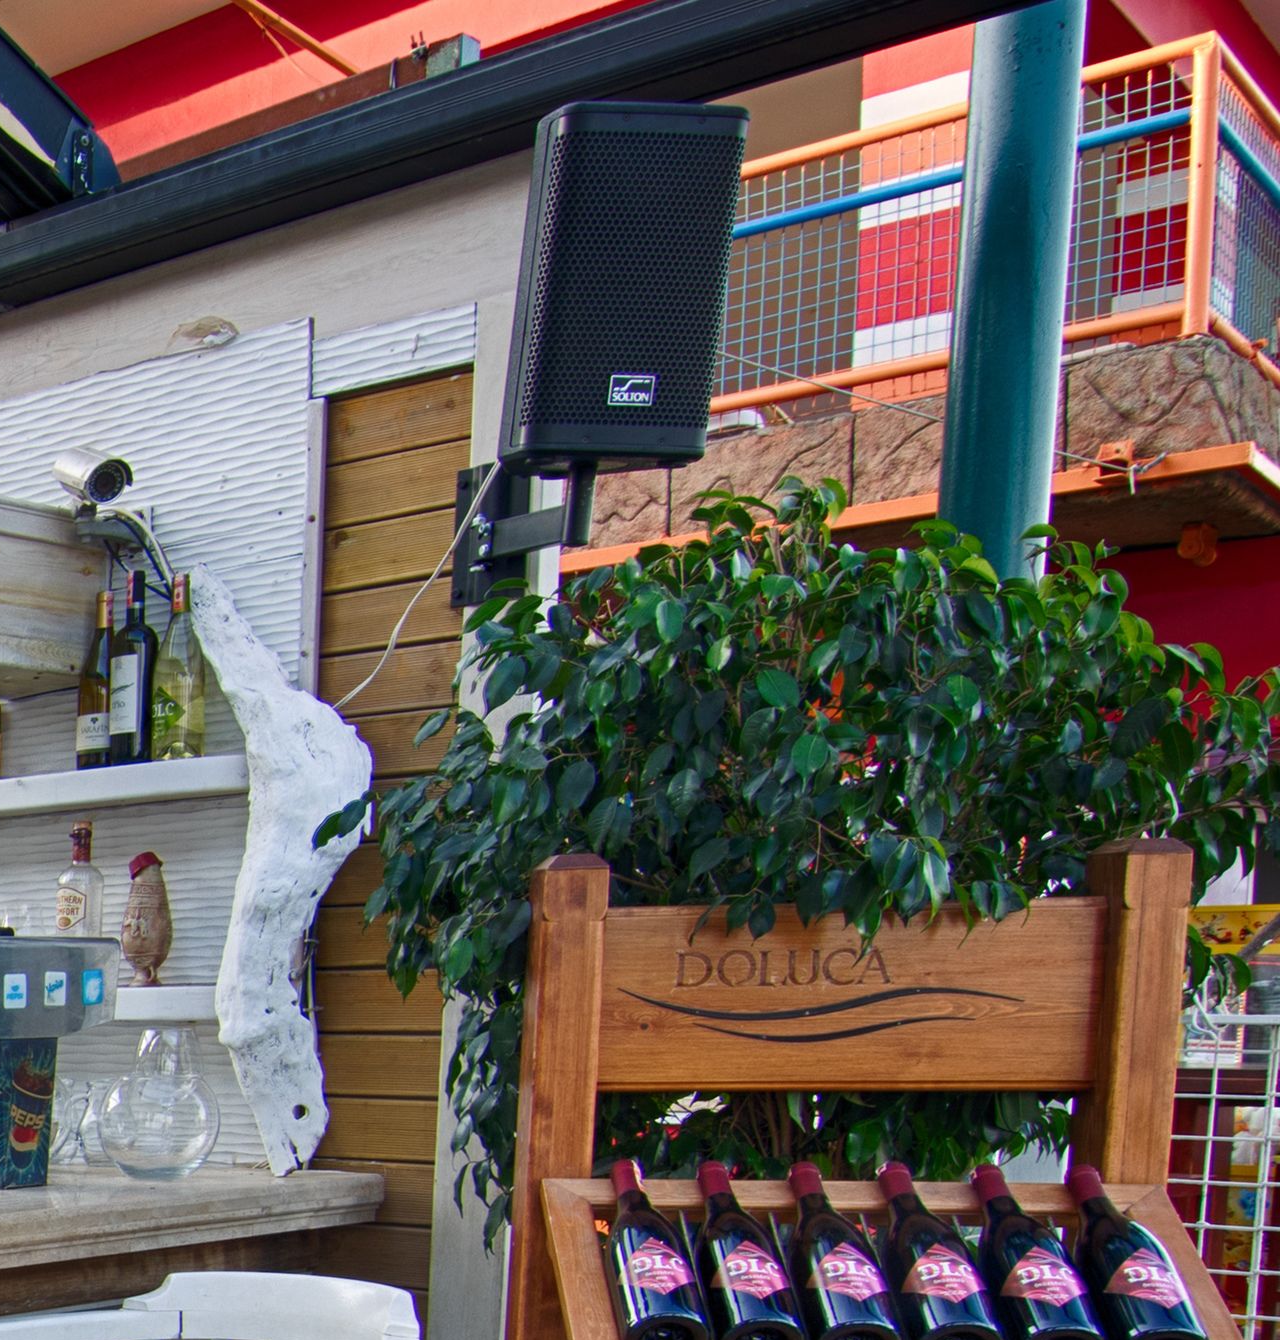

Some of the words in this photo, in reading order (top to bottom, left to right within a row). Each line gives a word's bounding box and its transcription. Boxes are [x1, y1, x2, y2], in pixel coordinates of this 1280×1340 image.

[612, 392, 650, 402] SOLTON
[60, 895, 83, 905] THERN
[675, 947, 894, 988] DOLUCA
[632, 1255, 683, 1273] DLC
[727, 1258, 779, 1277] DLC
[823, 1260, 876, 1280] DLC
[917, 1261, 975, 1281] DLC
[1017, 1265, 1076, 1284] DLC
[1124, 1264, 1178, 1284] DLC
